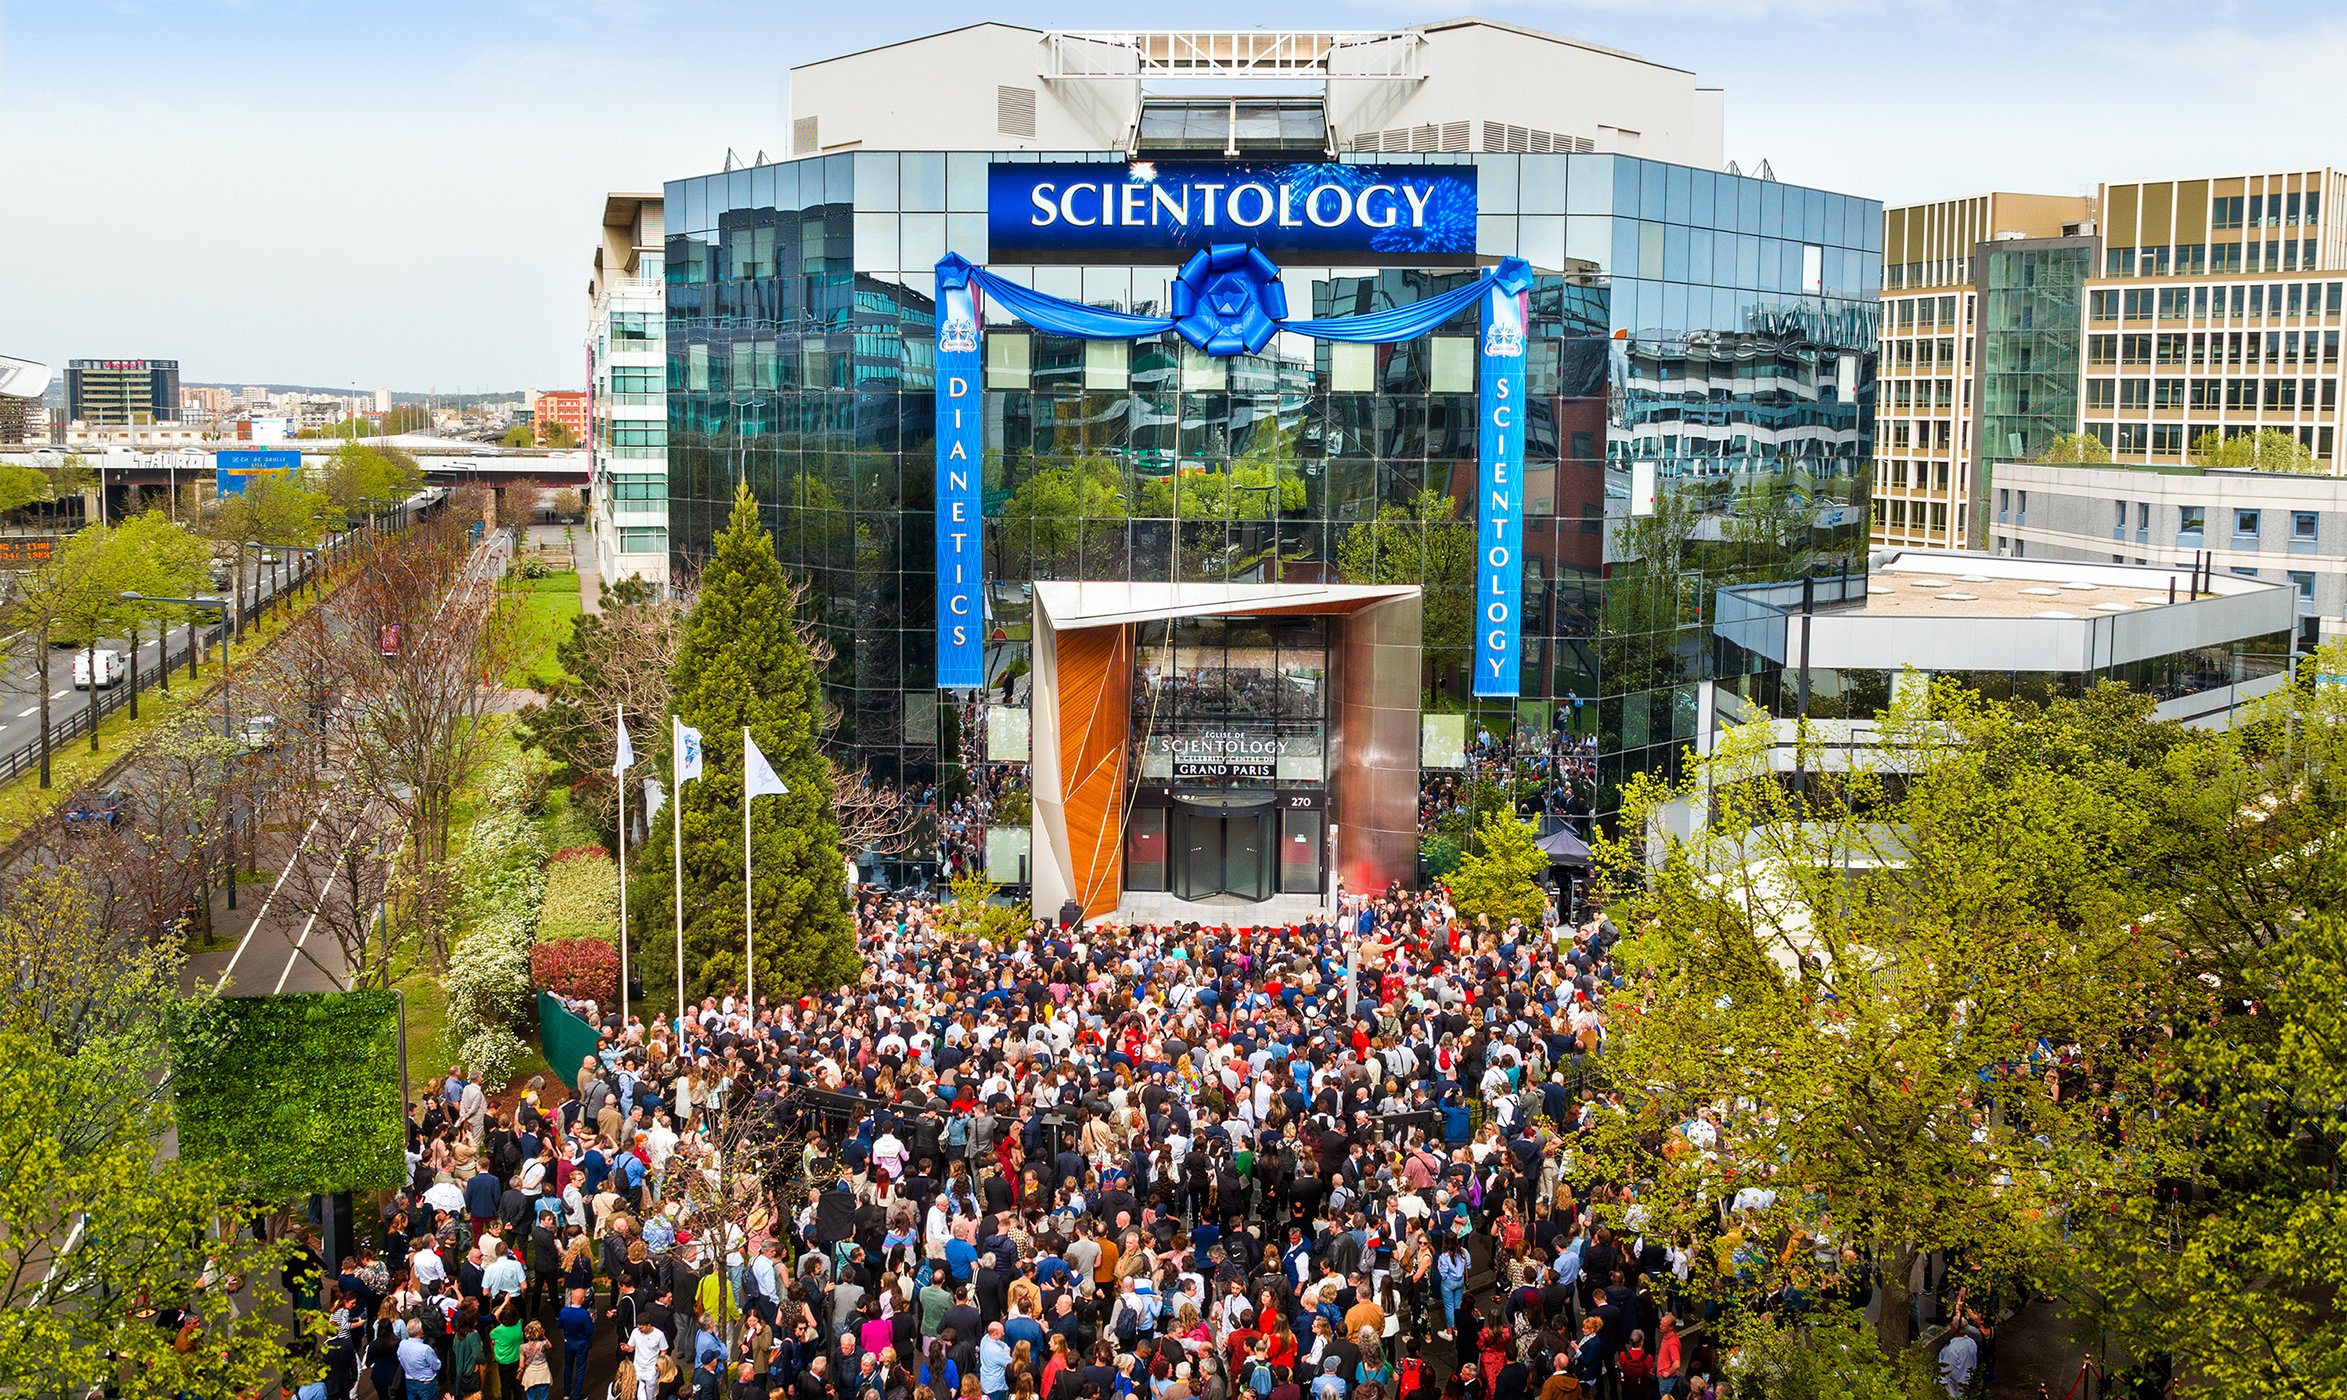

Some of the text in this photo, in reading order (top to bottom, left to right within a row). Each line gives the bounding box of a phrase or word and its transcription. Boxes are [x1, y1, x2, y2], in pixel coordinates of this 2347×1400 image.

[1030, 183, 1435, 228] SCIENTOLOGY
[949, 377, 968, 646] DIANETICS
[1487, 378, 1510, 678] SCIENTOLOGY
[1161, 739, 1289, 754] SCIENTOLOGY
[1179, 764, 1270, 776] GRAND PARIS
[1291, 797, 1312, 807] 270
